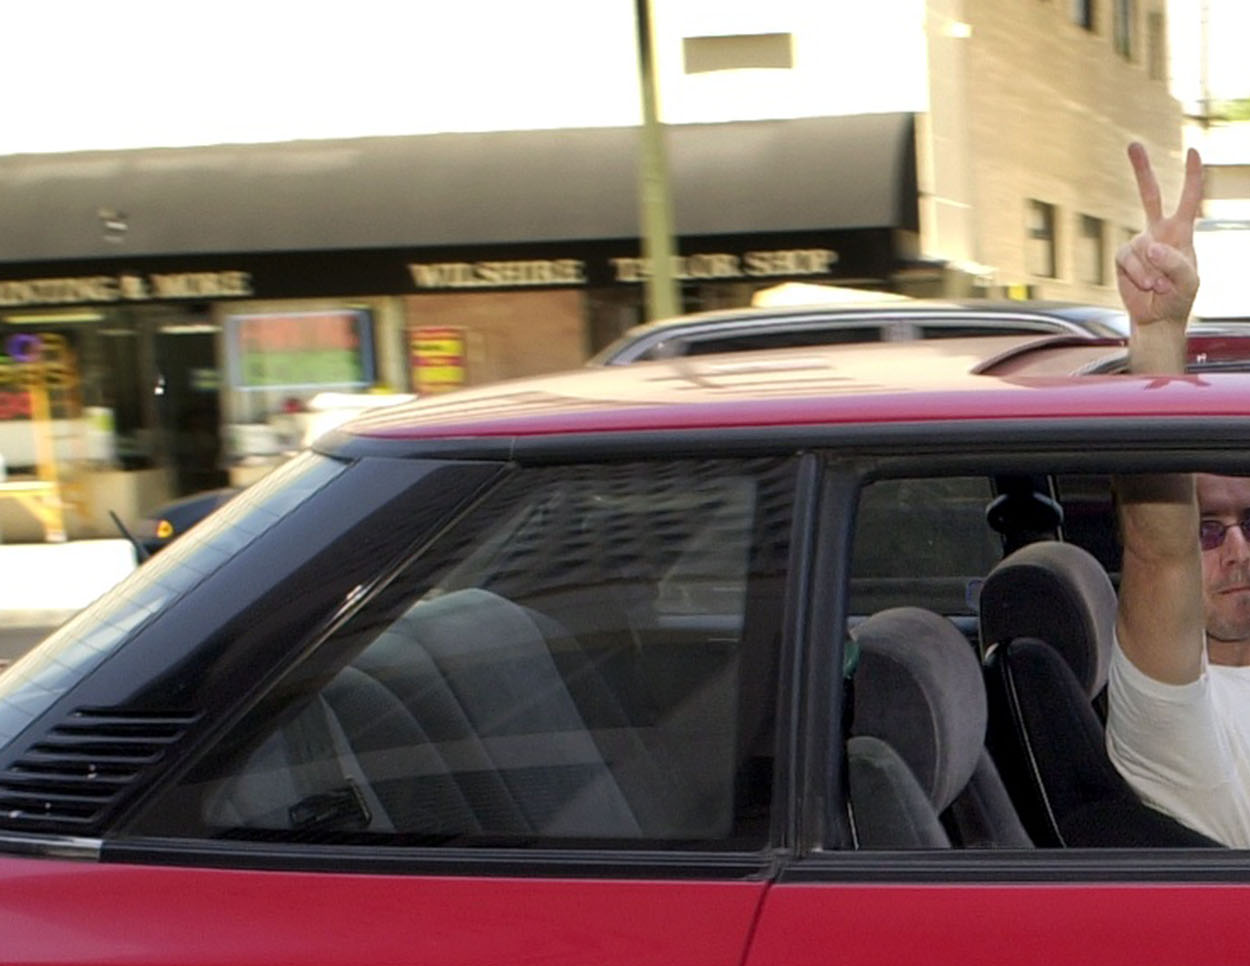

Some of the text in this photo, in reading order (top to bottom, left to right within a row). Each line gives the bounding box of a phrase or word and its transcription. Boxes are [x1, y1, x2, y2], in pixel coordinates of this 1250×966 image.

[408, 248, 838, 289] WILSHIRE TLOR SHOP
